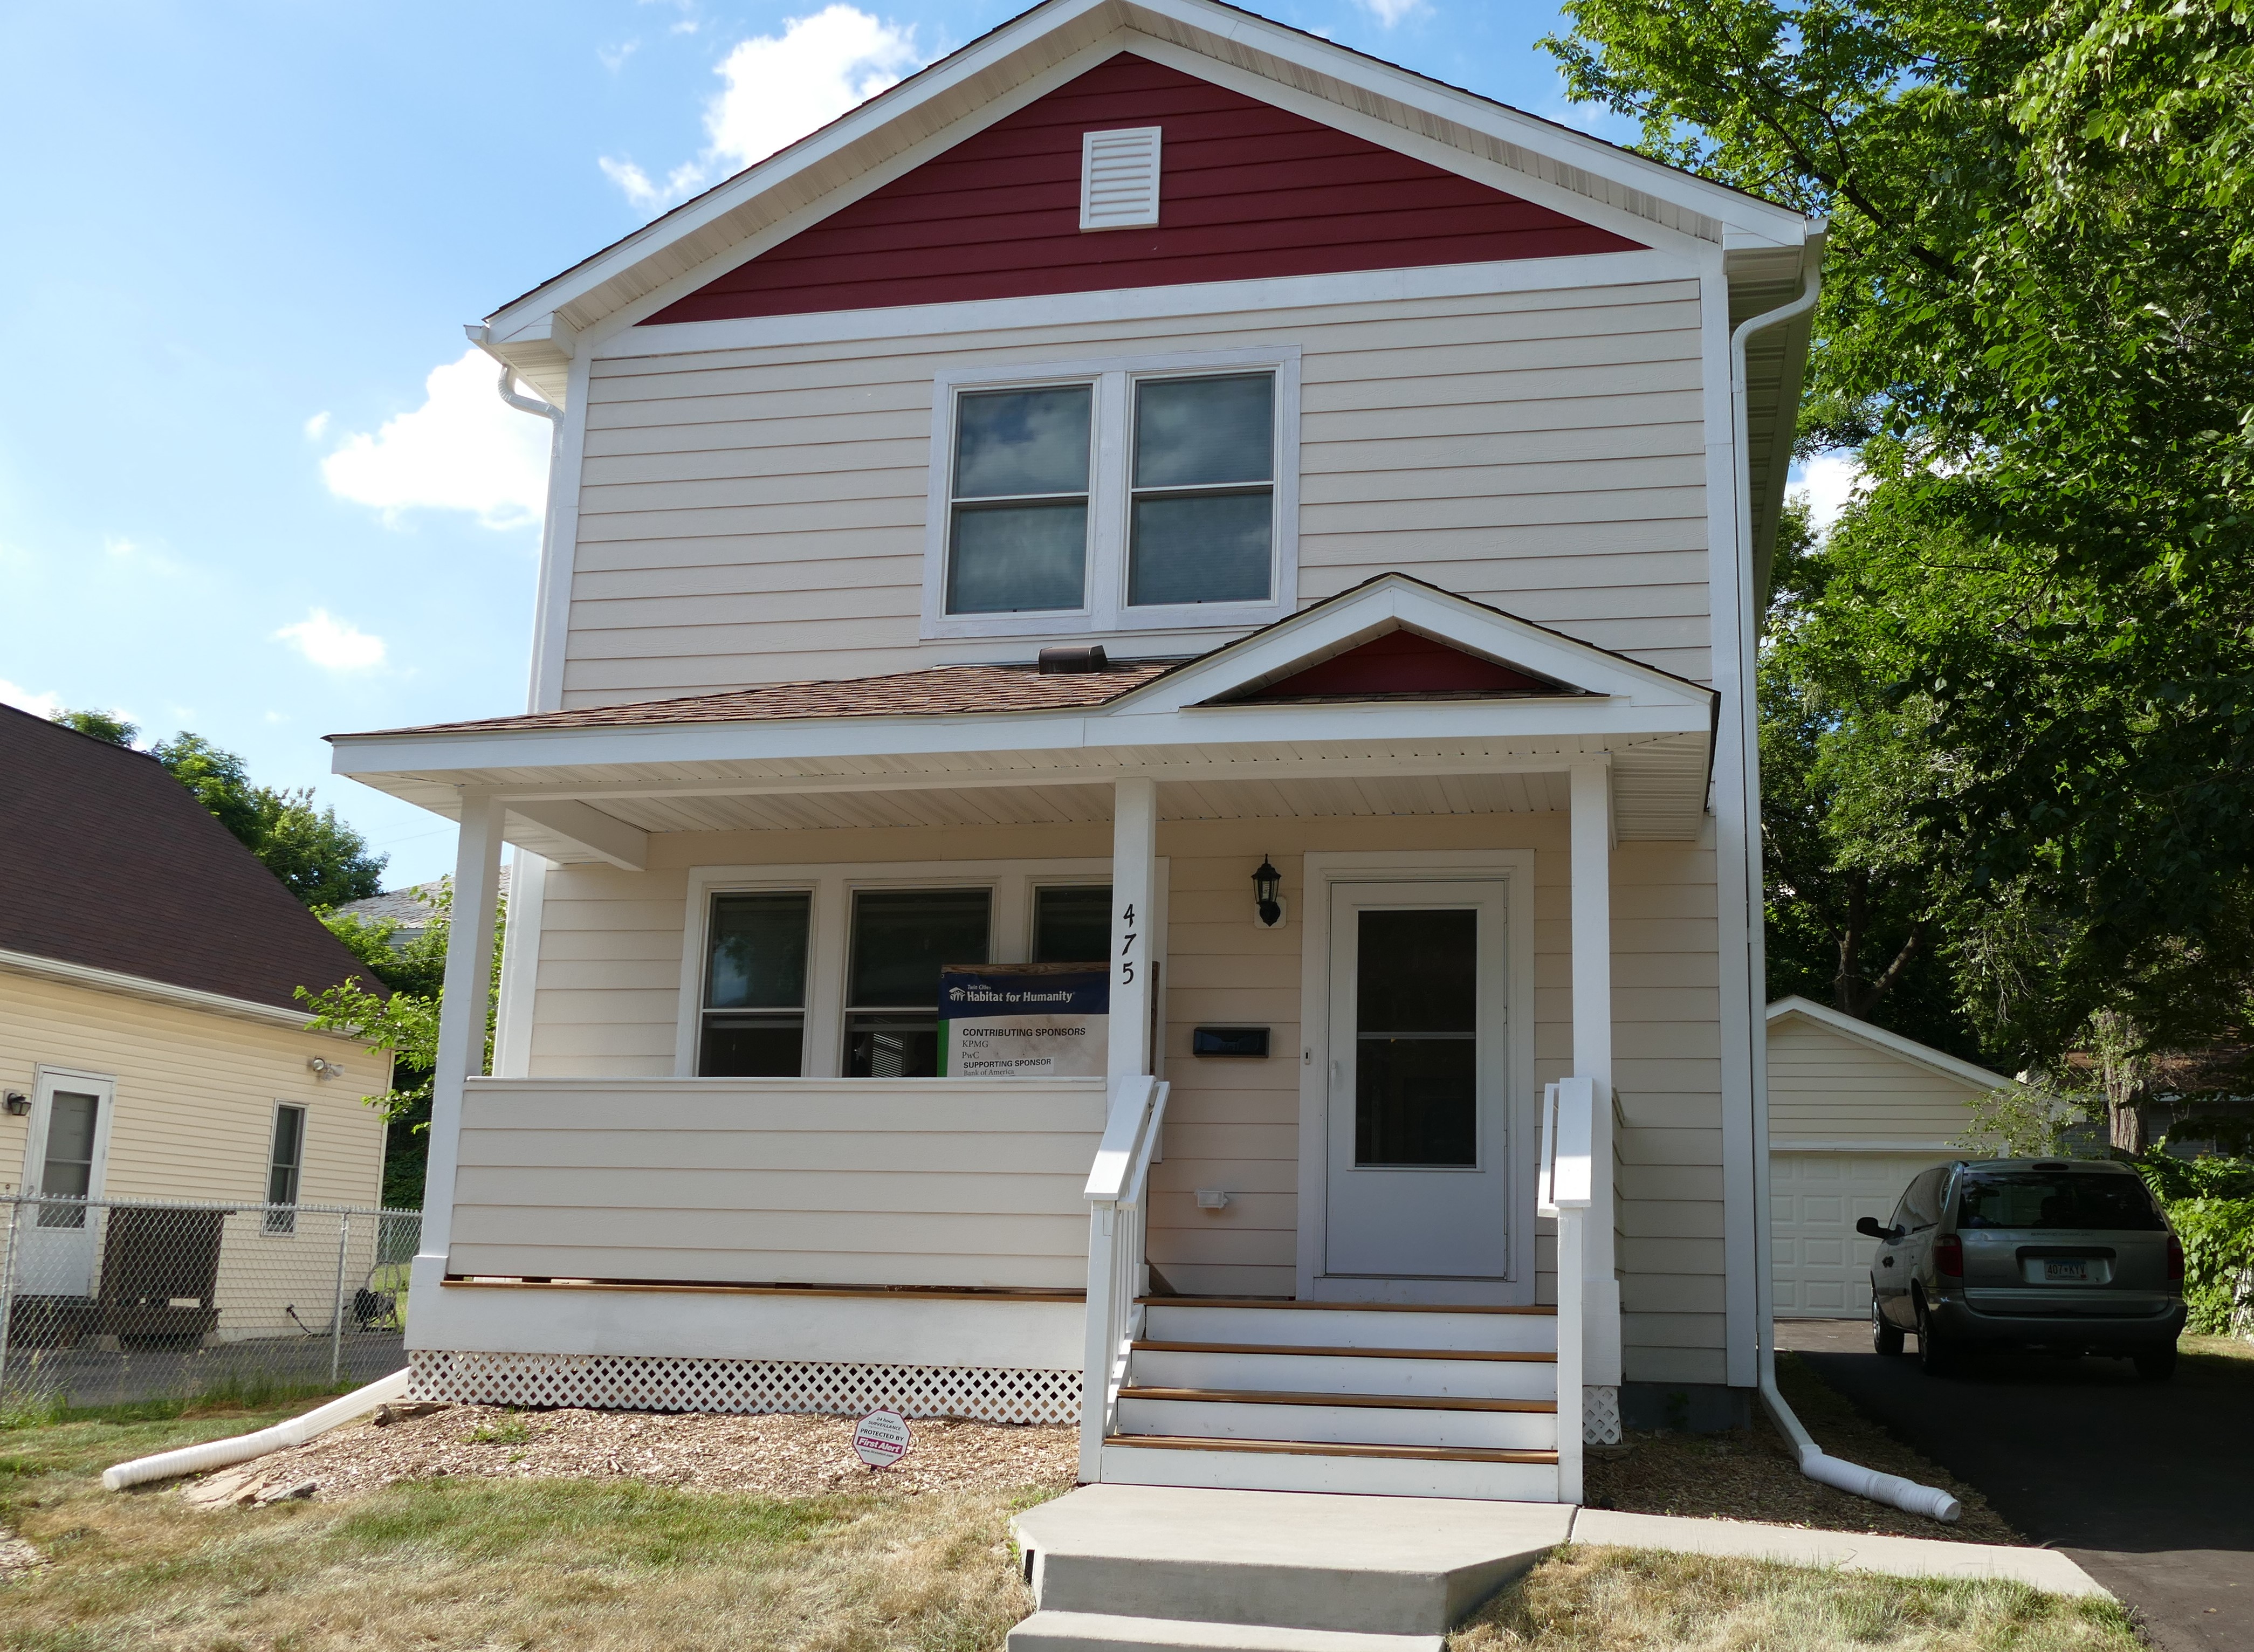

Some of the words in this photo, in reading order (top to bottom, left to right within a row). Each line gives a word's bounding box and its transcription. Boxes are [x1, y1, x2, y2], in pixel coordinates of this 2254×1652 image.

[1122, 904, 1137, 985] 475
[967, 991, 1004, 1002] Habitat
[1006, 992, 1020, 1002] for
[1022, 990, 1073, 1003] Humanity
[963, 1028, 1033, 1037] CONTRIBUTING
[1035, 1028, 1086, 1037] SPONSORS
[964, 1060, 1013, 1069] SUPPORTING
[1015, 1058, 1052, 1066] SPONSOR
[2047, 1264, 2062, 1274] 407
[2069, 1264, 2085, 1275] KYV
[868, 1421, 901, 1431] SURVEILLANCE
[860, 1428, 894, 1440] PROTECTED
[858, 1438, 878, 1448] First
[878, 1443, 899, 1453] Alert
